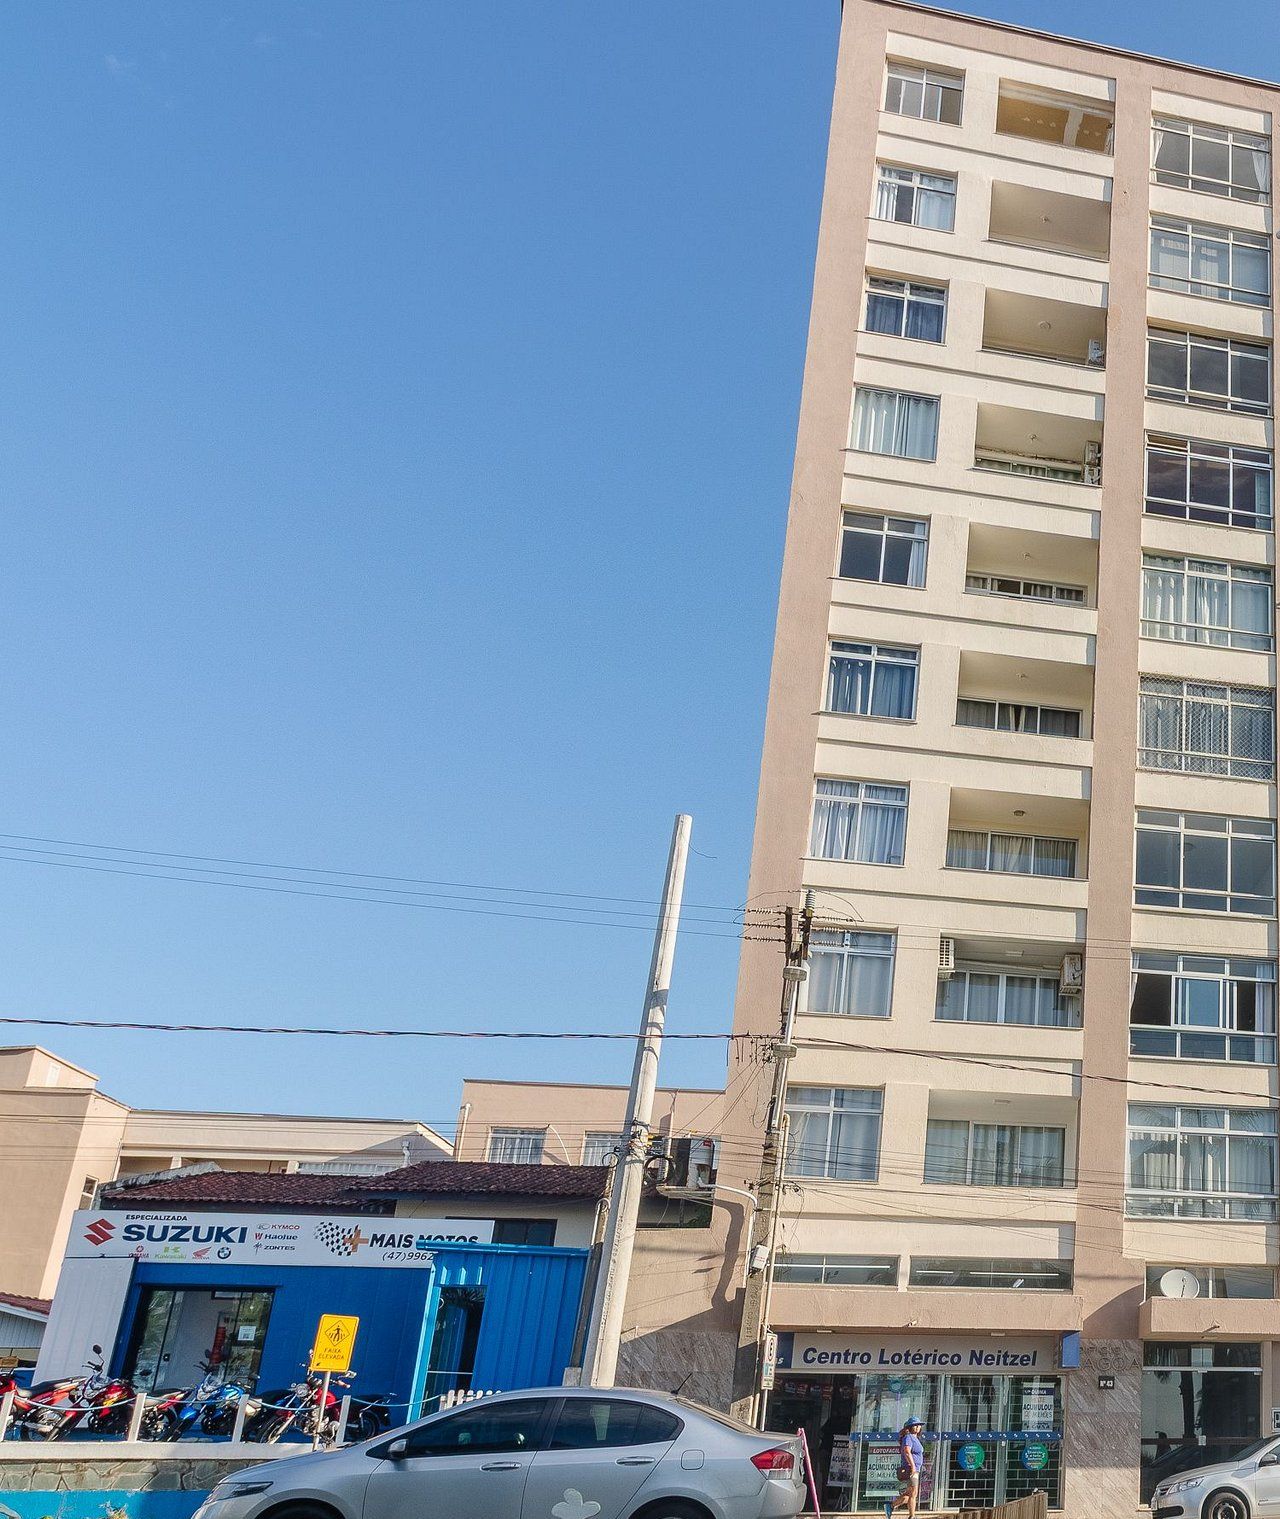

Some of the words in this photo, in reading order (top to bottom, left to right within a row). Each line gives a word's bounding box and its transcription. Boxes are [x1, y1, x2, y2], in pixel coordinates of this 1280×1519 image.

[122, 1224, 248, 1243] SUZUKI
[369, 1233, 414, 1249] MAIS
[382, 1251, 434, 1261] (47)9962
[803, 1347, 872, 1365] Centro
[878, 1348, 962, 1366] Lotérico
[968, 1350, 1037, 1367] Neitzel
